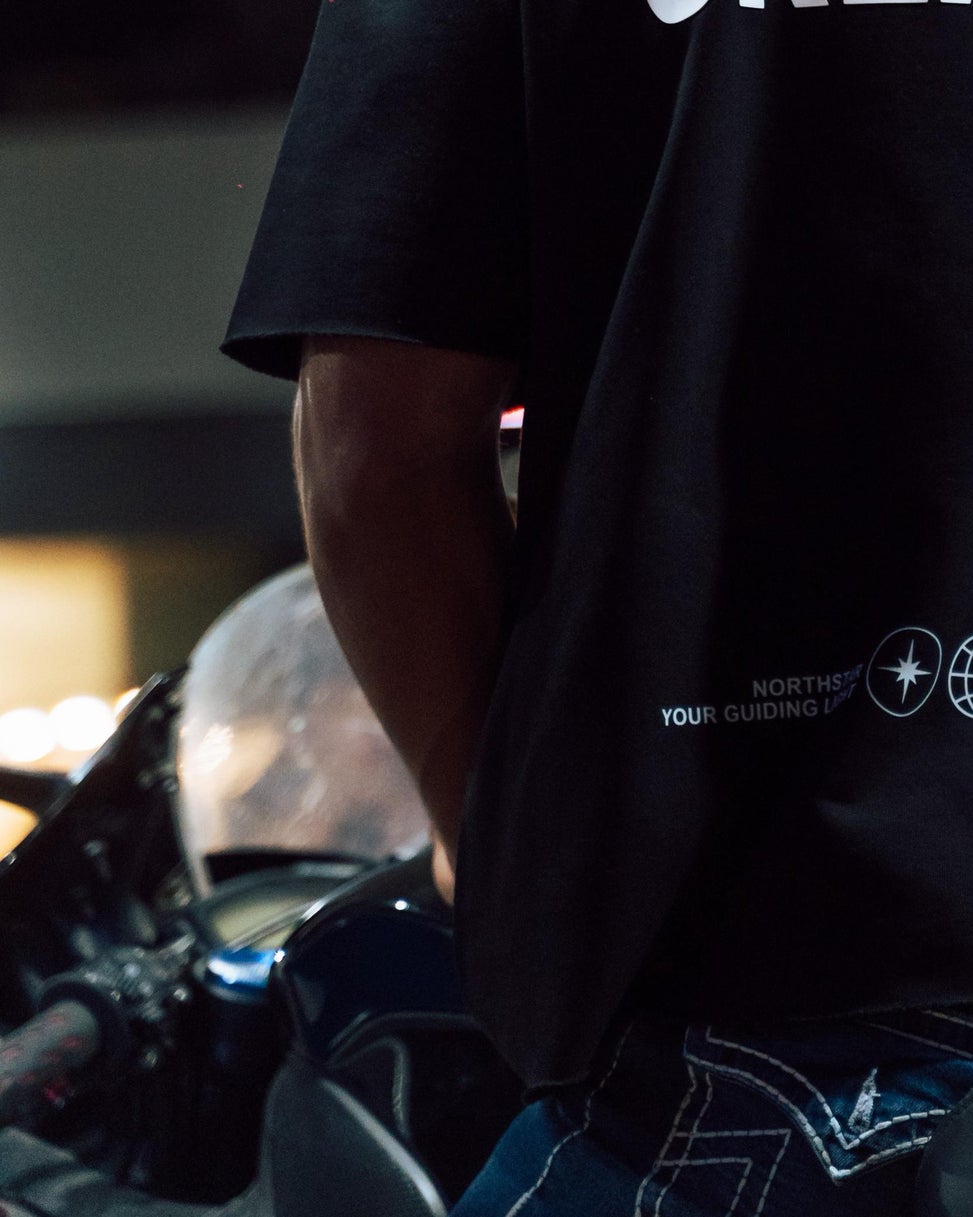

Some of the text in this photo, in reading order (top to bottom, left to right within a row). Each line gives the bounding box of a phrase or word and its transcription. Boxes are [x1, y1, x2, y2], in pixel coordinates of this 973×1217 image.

[752, 663, 864, 698] NORTHS
[662, 706, 718, 727] YOUR
[724, 698, 819, 723] GUIDING
